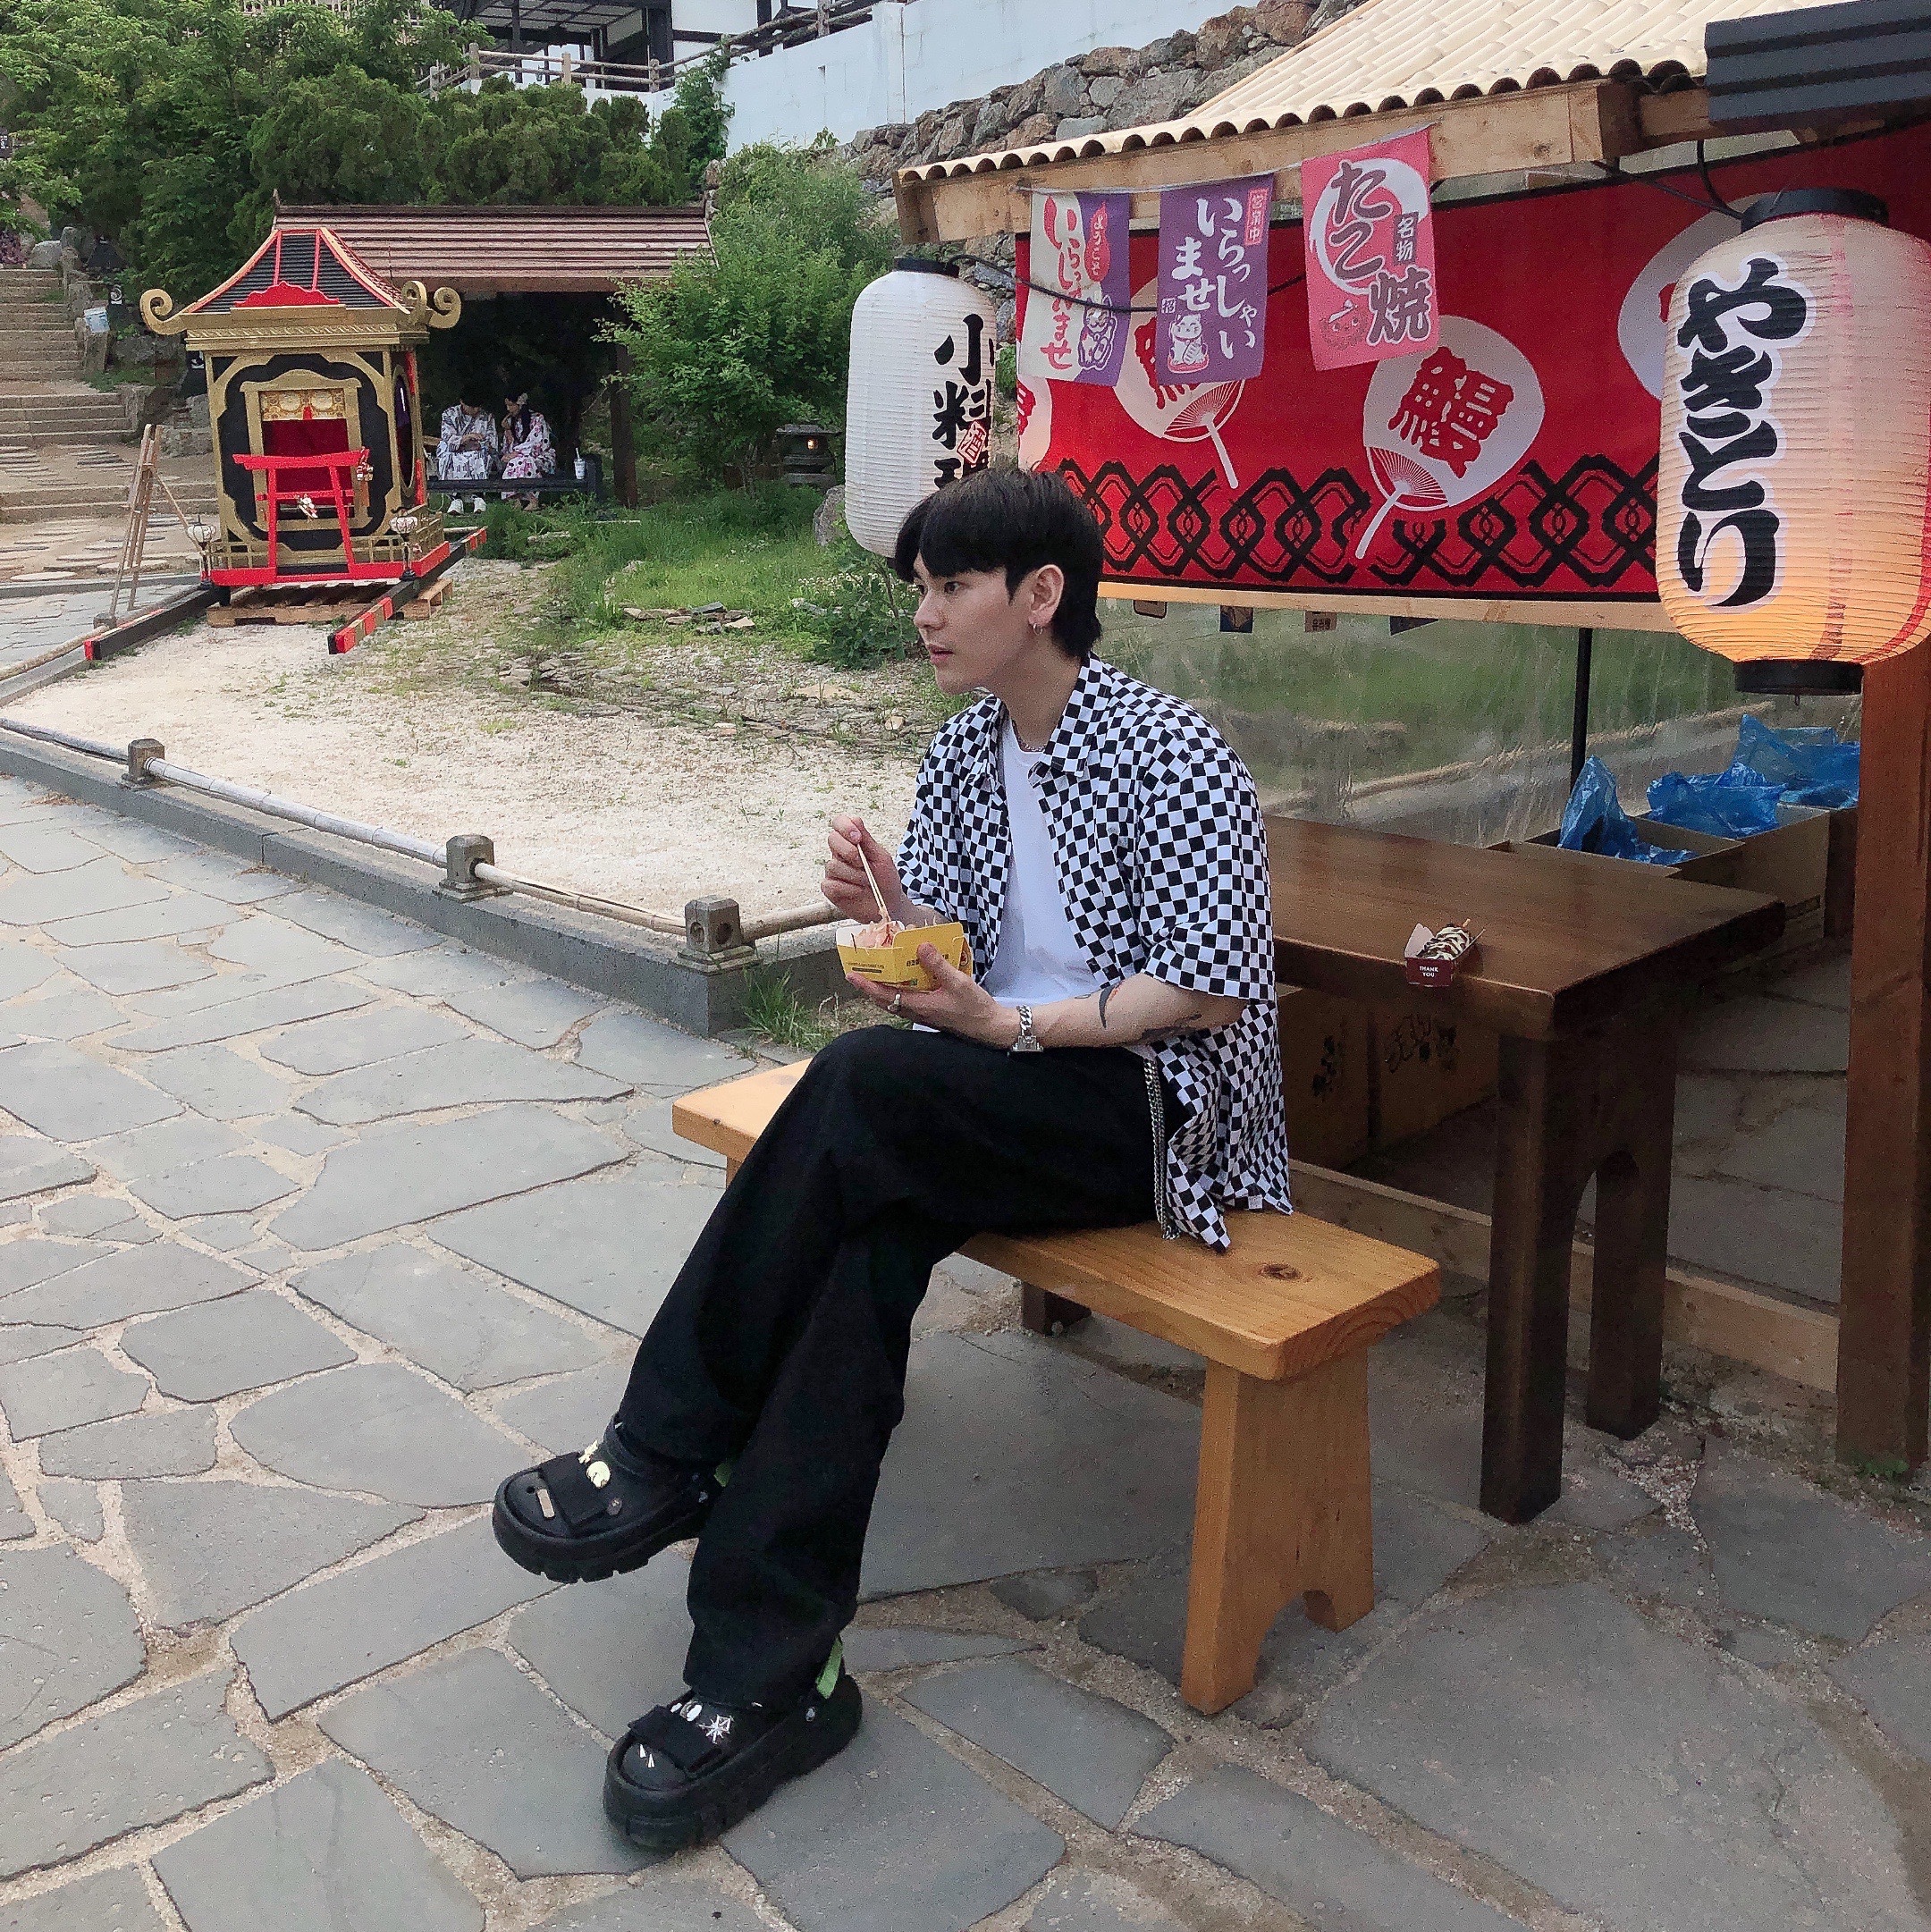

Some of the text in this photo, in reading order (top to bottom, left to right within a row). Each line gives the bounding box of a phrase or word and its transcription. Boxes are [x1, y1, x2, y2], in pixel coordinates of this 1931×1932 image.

[1329, 160, 1432, 346] たこ焼
[1396, 217, 1415, 262] 名物
[1677, 256, 1808, 607] やきとり
